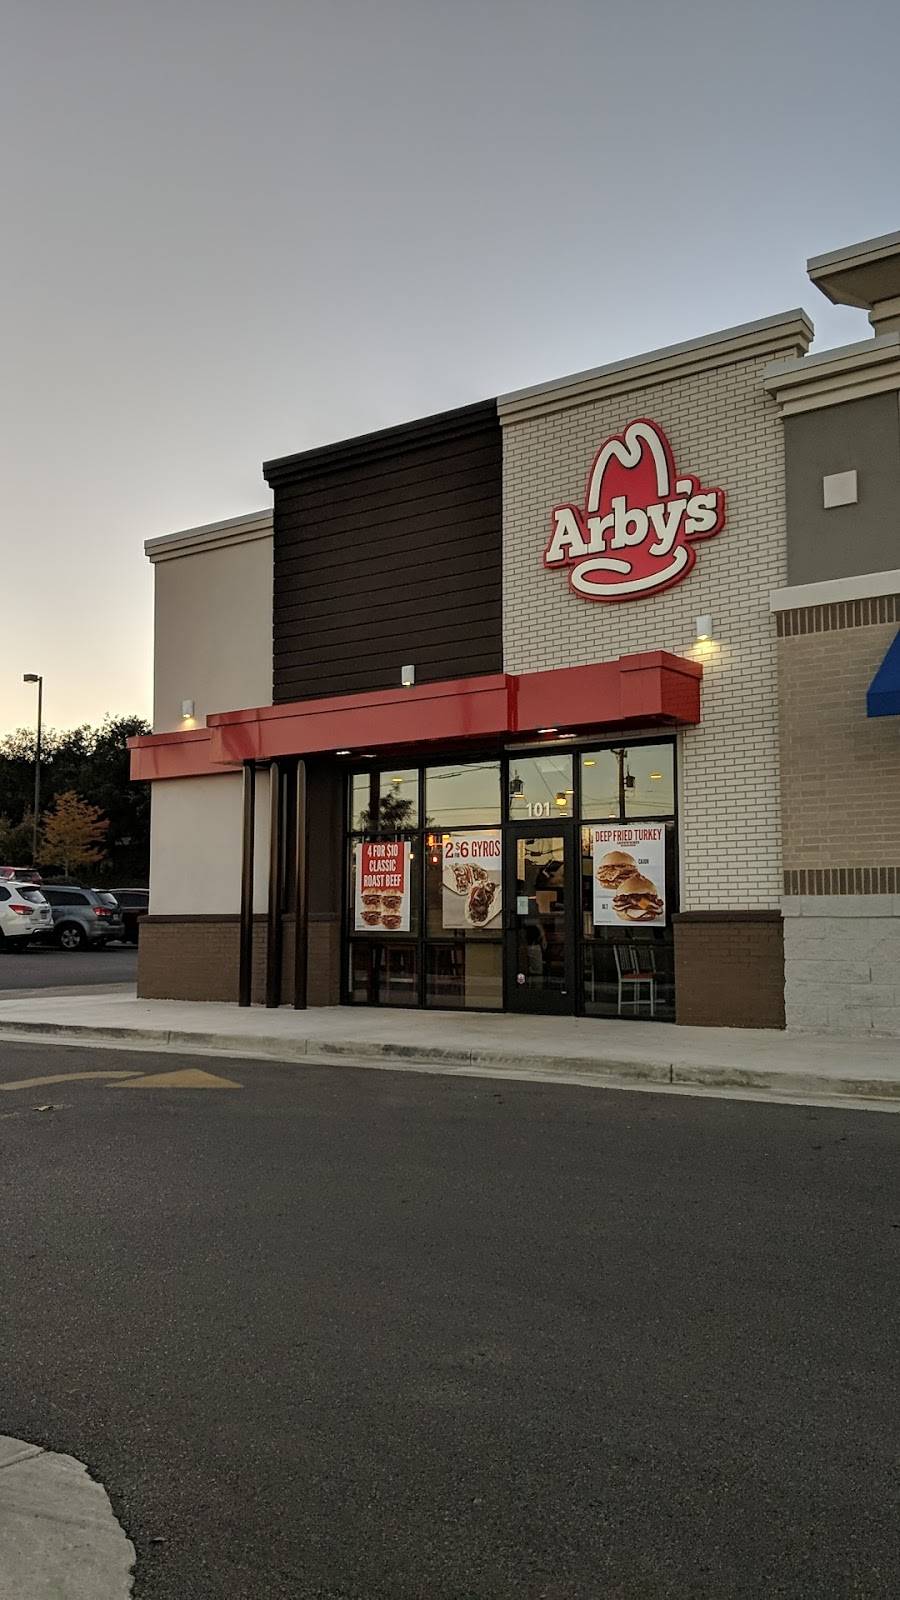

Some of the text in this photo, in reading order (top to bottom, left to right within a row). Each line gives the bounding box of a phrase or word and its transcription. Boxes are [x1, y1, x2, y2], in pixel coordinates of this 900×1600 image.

[546, 479, 717, 562] Arby's
[526, 802, 550, 817] 101
[595, 828, 662, 842] DEEP FRIED TURKEY
[367, 844, 398, 857] 4 FOR $10
[445, 842, 454, 858] 2
[471, 840, 501, 857] GYROS
[369, 859, 397, 872] CLASSIC
[363, 874, 402, 887] ROAST BEEF
